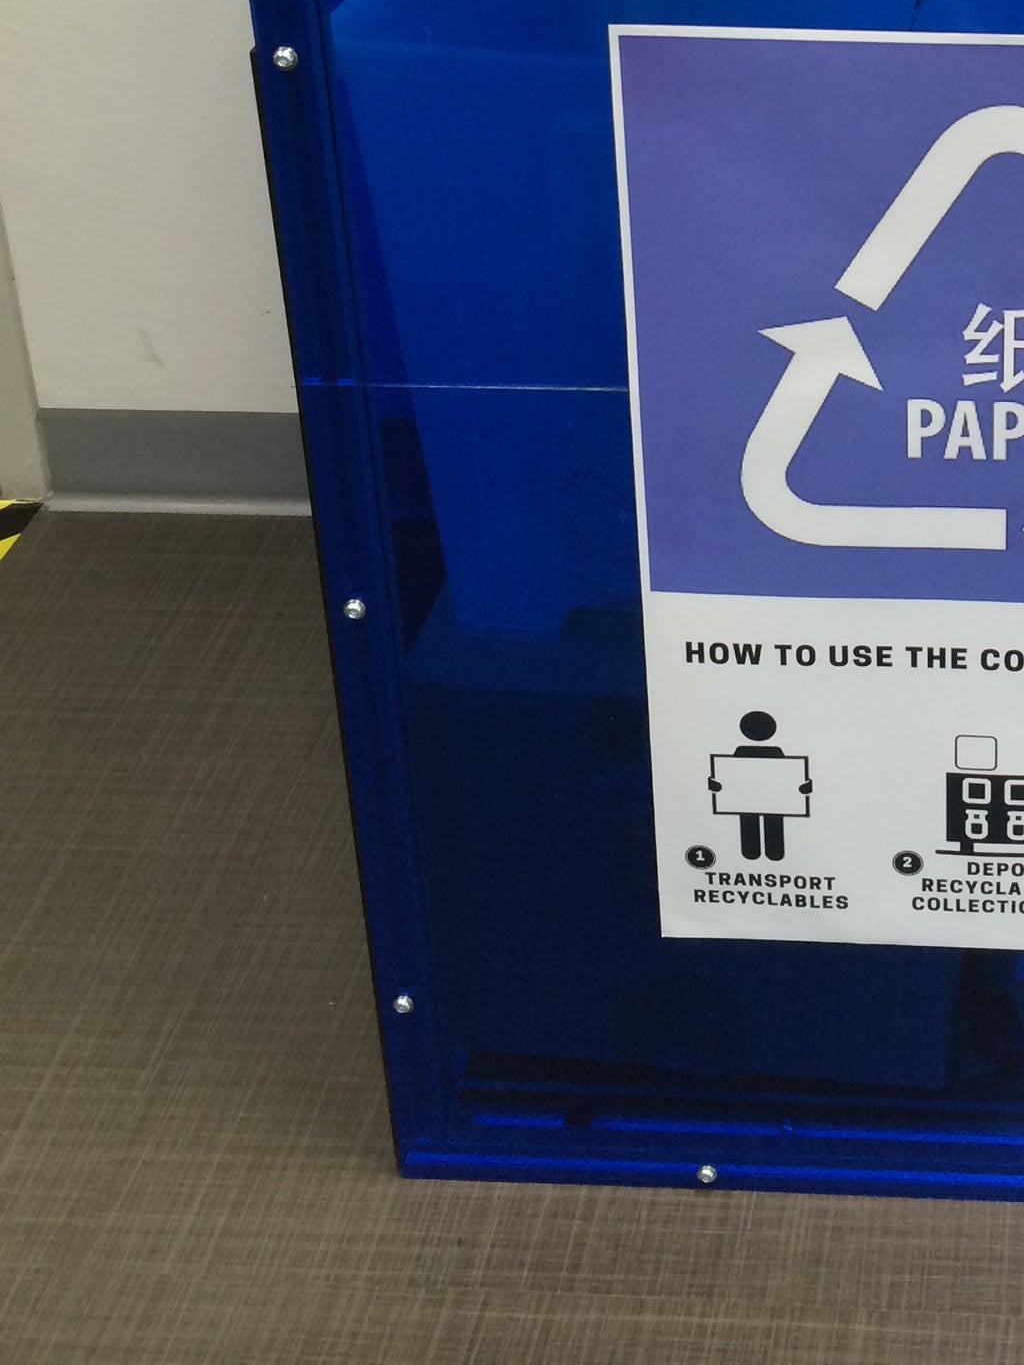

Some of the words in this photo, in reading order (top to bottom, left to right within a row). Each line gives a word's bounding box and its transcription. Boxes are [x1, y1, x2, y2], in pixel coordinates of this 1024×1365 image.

[685, 641, 762, 665] HOW
[774, 644, 816, 666] TO
[829, 645, 893, 667] USE
[905, 646, 968, 669] THE
[695, 850, 705, 862] 1
[902, 856, 913, 868] 2
[704, 872, 836, 891] TRANSPORT
[693, 889, 849, 910] RECYCLABLES
